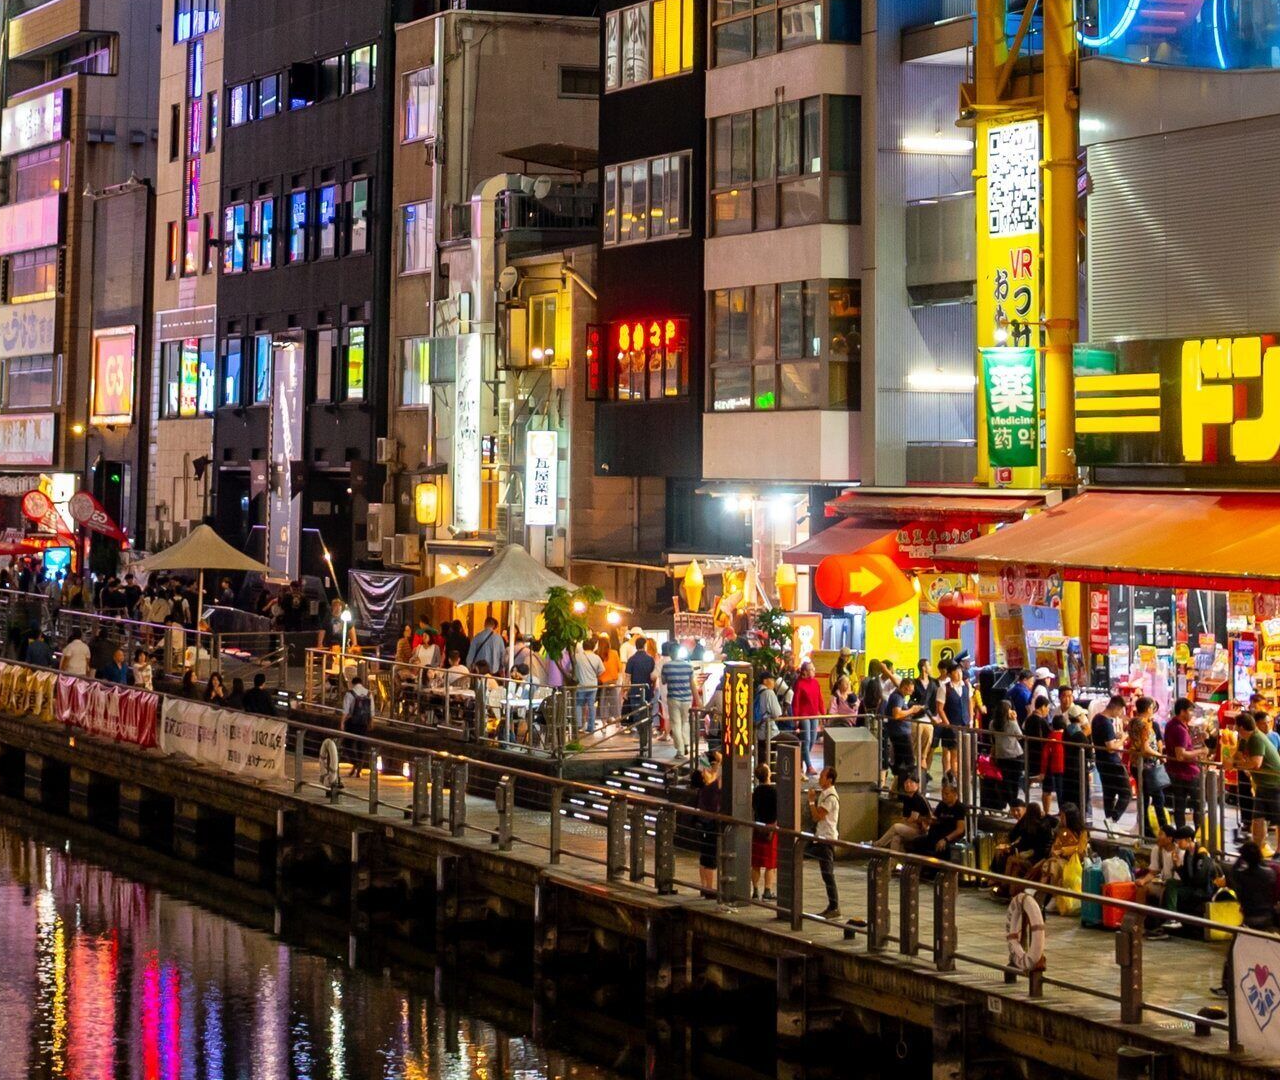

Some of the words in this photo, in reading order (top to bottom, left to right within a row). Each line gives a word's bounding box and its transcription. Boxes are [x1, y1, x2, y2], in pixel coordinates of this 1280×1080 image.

[104, 354, 124, 396] G3
[989, 365, 1035, 413] 薬
[991, 415, 1036, 426] Medicine
